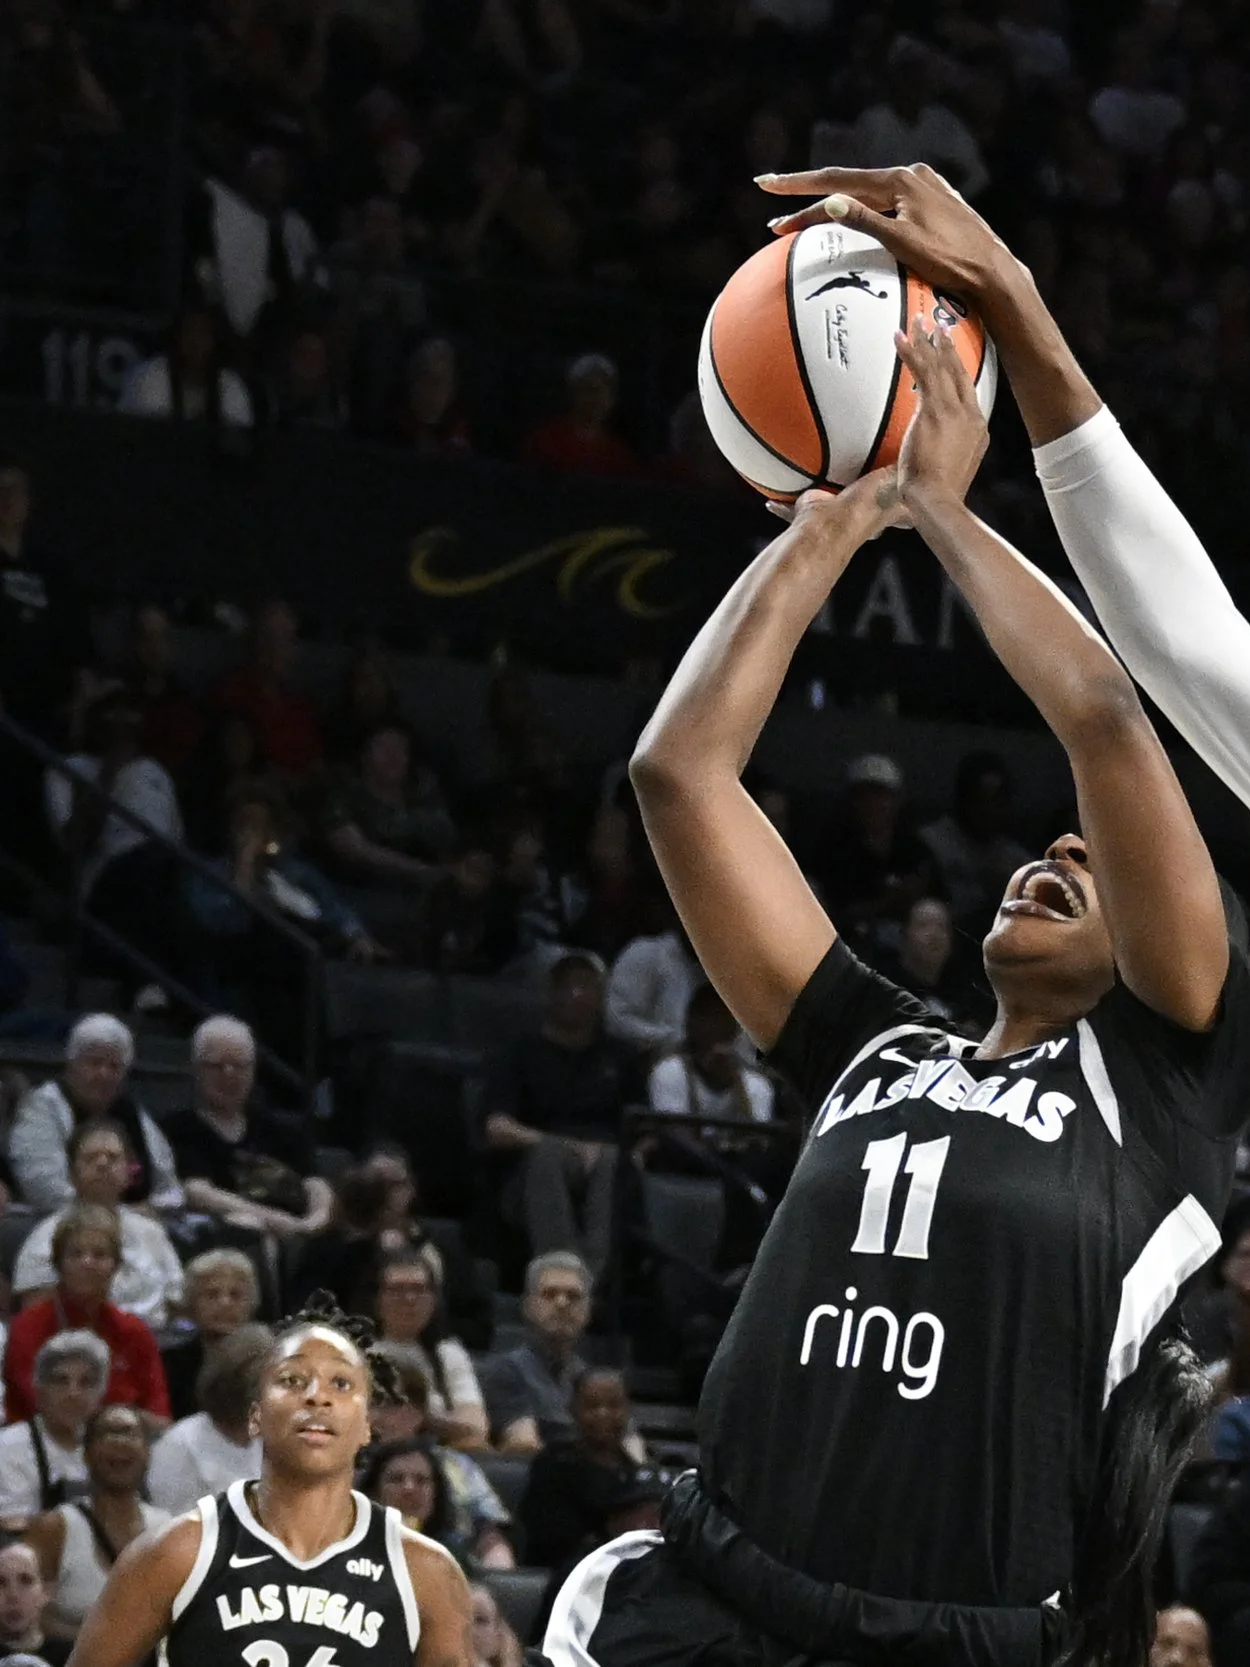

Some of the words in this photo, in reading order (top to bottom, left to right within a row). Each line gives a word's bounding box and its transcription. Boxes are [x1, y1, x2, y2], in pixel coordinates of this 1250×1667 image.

[817, 1073, 917, 1137] LAS
[907, 1058, 1077, 1142] VEGAS
[850, 1131, 951, 1260] 11
[799, 1286, 945, 1400] ring
[345, 1557, 386, 1582] ally
[215, 1583, 286, 1631] LAS
[286, 1584, 386, 1649] VEGAS
